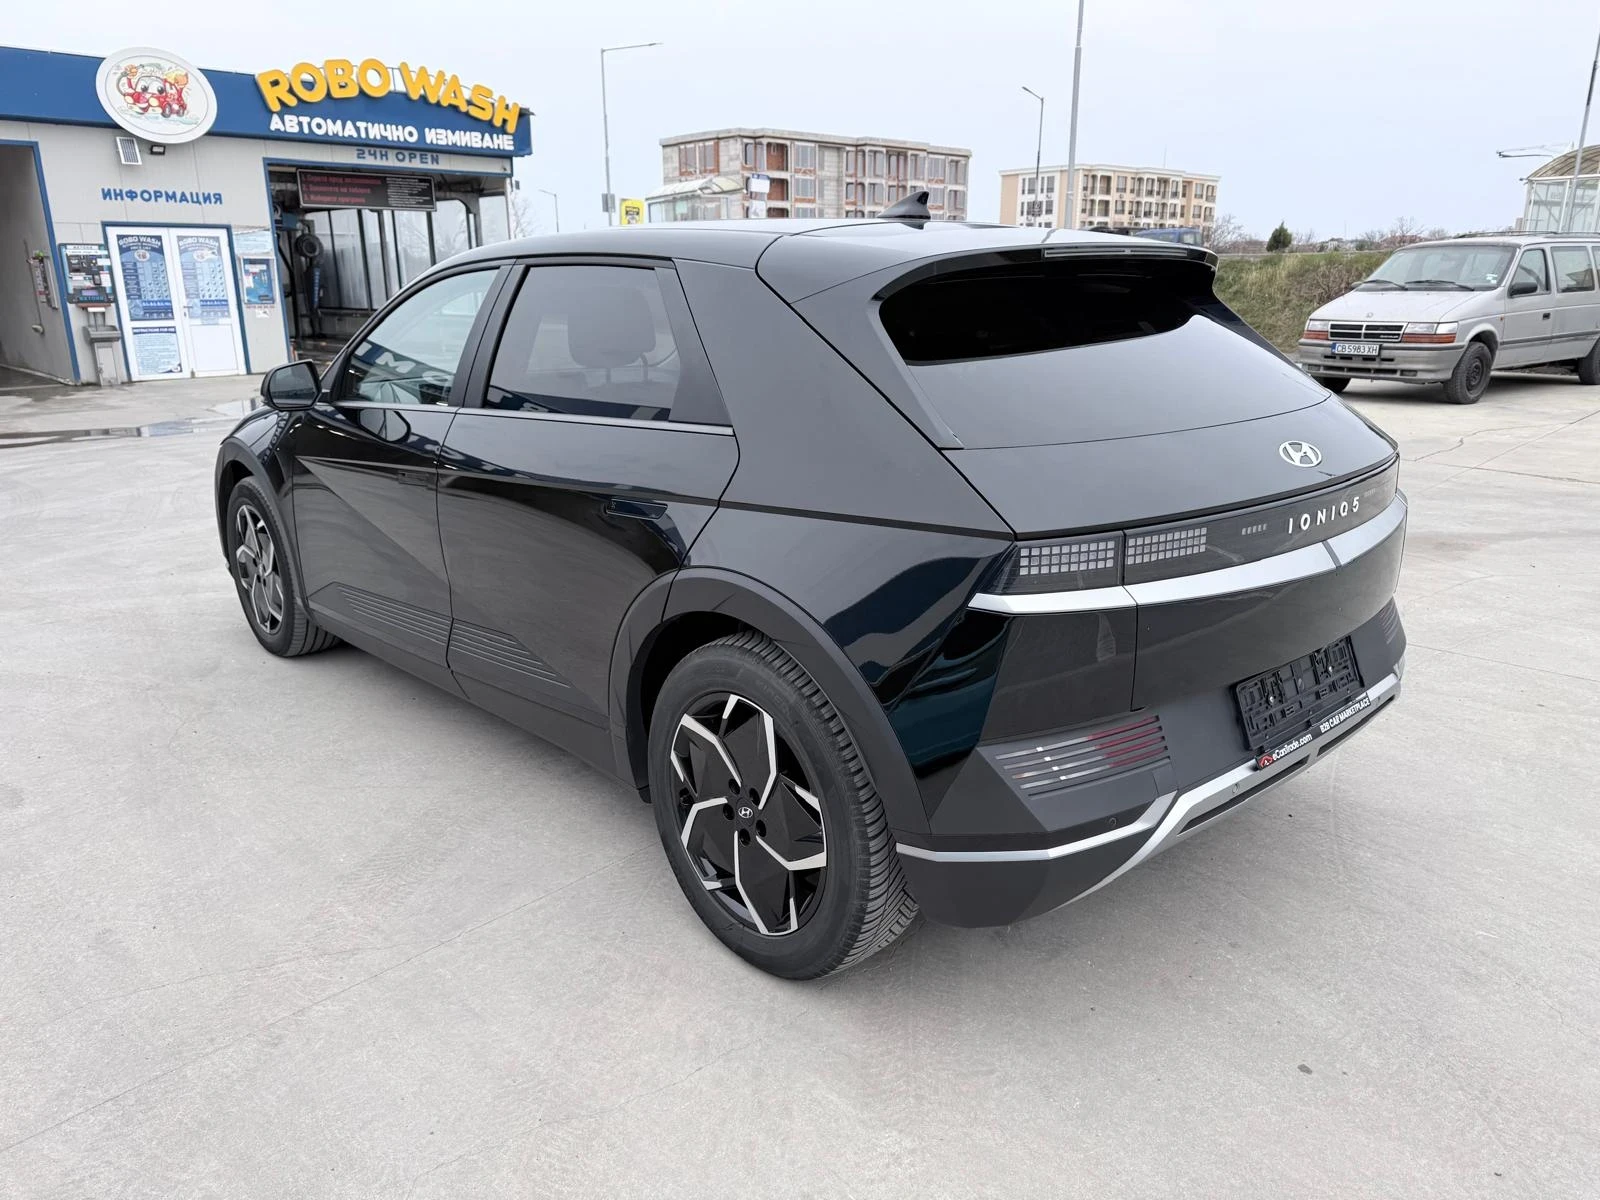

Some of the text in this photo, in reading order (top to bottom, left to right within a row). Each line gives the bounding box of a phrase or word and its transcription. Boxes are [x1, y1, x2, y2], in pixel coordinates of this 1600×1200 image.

[257, 59, 520, 134] ROBO WASH
[269, 113, 515, 151] АВТОМАТИЧНО ИЗМИВАНЕ
[356, 148, 440, 165] 24H OPEN
[102, 188, 223, 205] ИНФОРМАЦИЯ
[139, 235, 161, 247] WASH
[1348, 344, 1366, 354] 5983
[1329, 715, 1341, 728] CAR
[1340, 697, 1371, 722] MARKETPLACE
